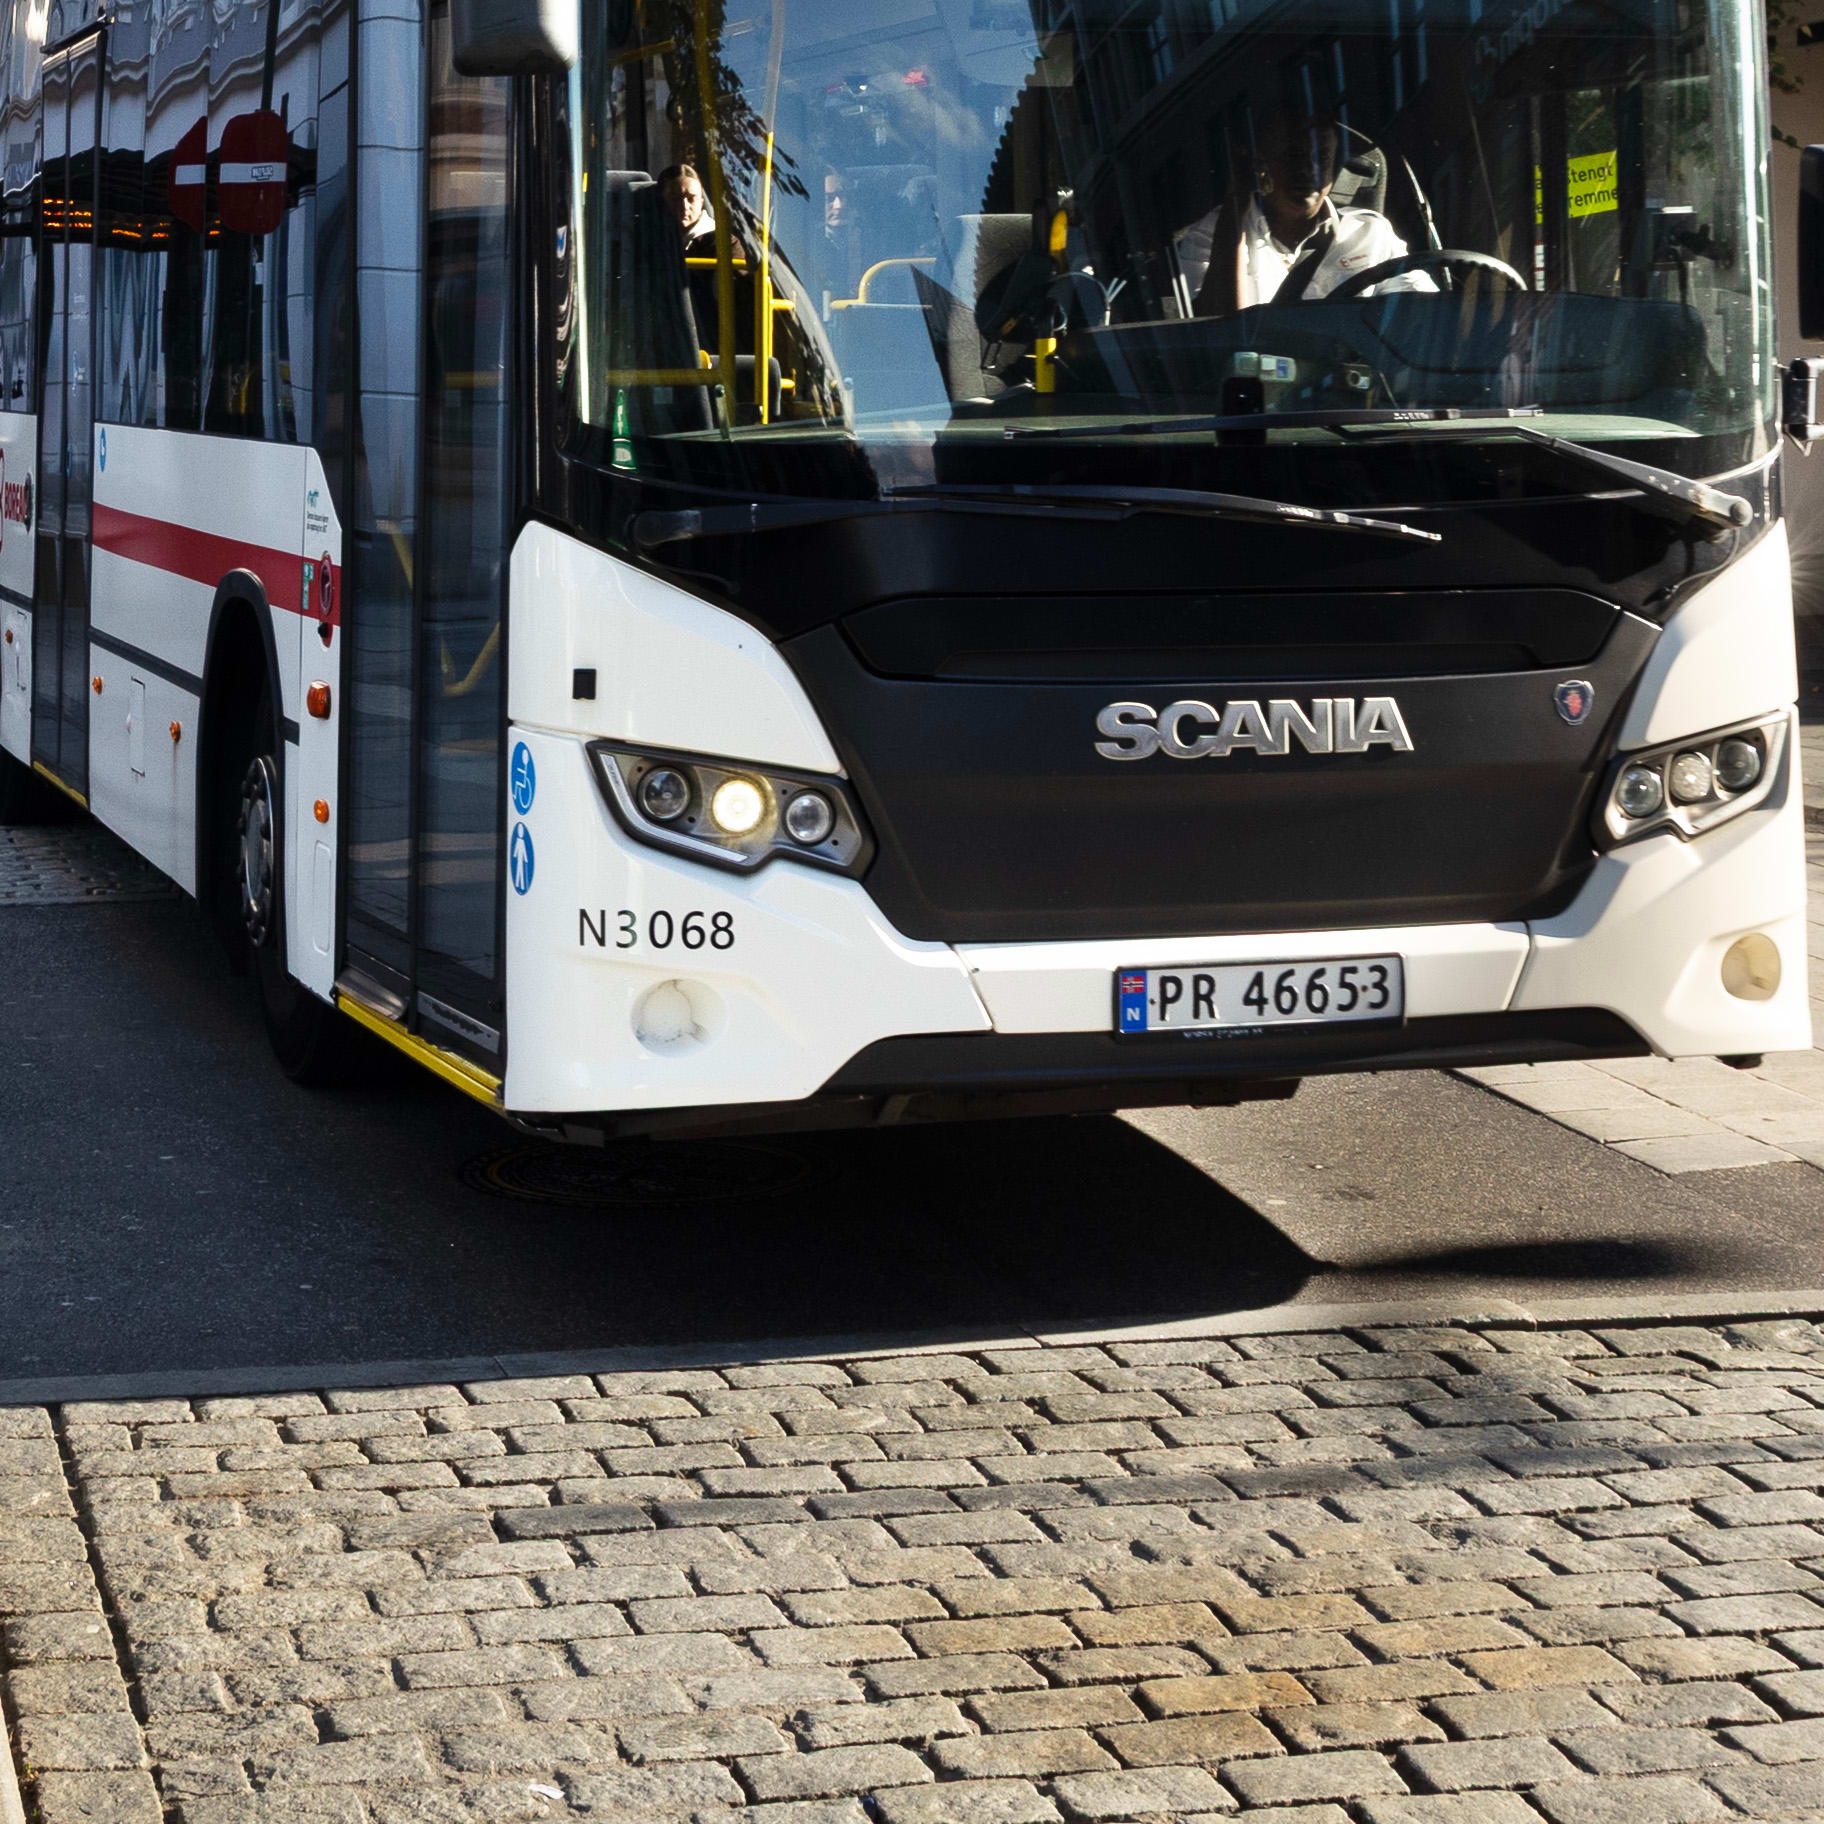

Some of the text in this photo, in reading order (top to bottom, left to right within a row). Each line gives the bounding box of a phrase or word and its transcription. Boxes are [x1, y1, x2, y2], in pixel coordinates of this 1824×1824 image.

[1567, 165, 1613, 184] tengt
[4, 481, 26, 523] BOREA
[1093, 695, 1415, 761] SCANIA
[577, 907, 736, 951] N3068
[1127, 1007, 1141, 1021] N
[1159, 964, 1389, 1021] PR 46653
